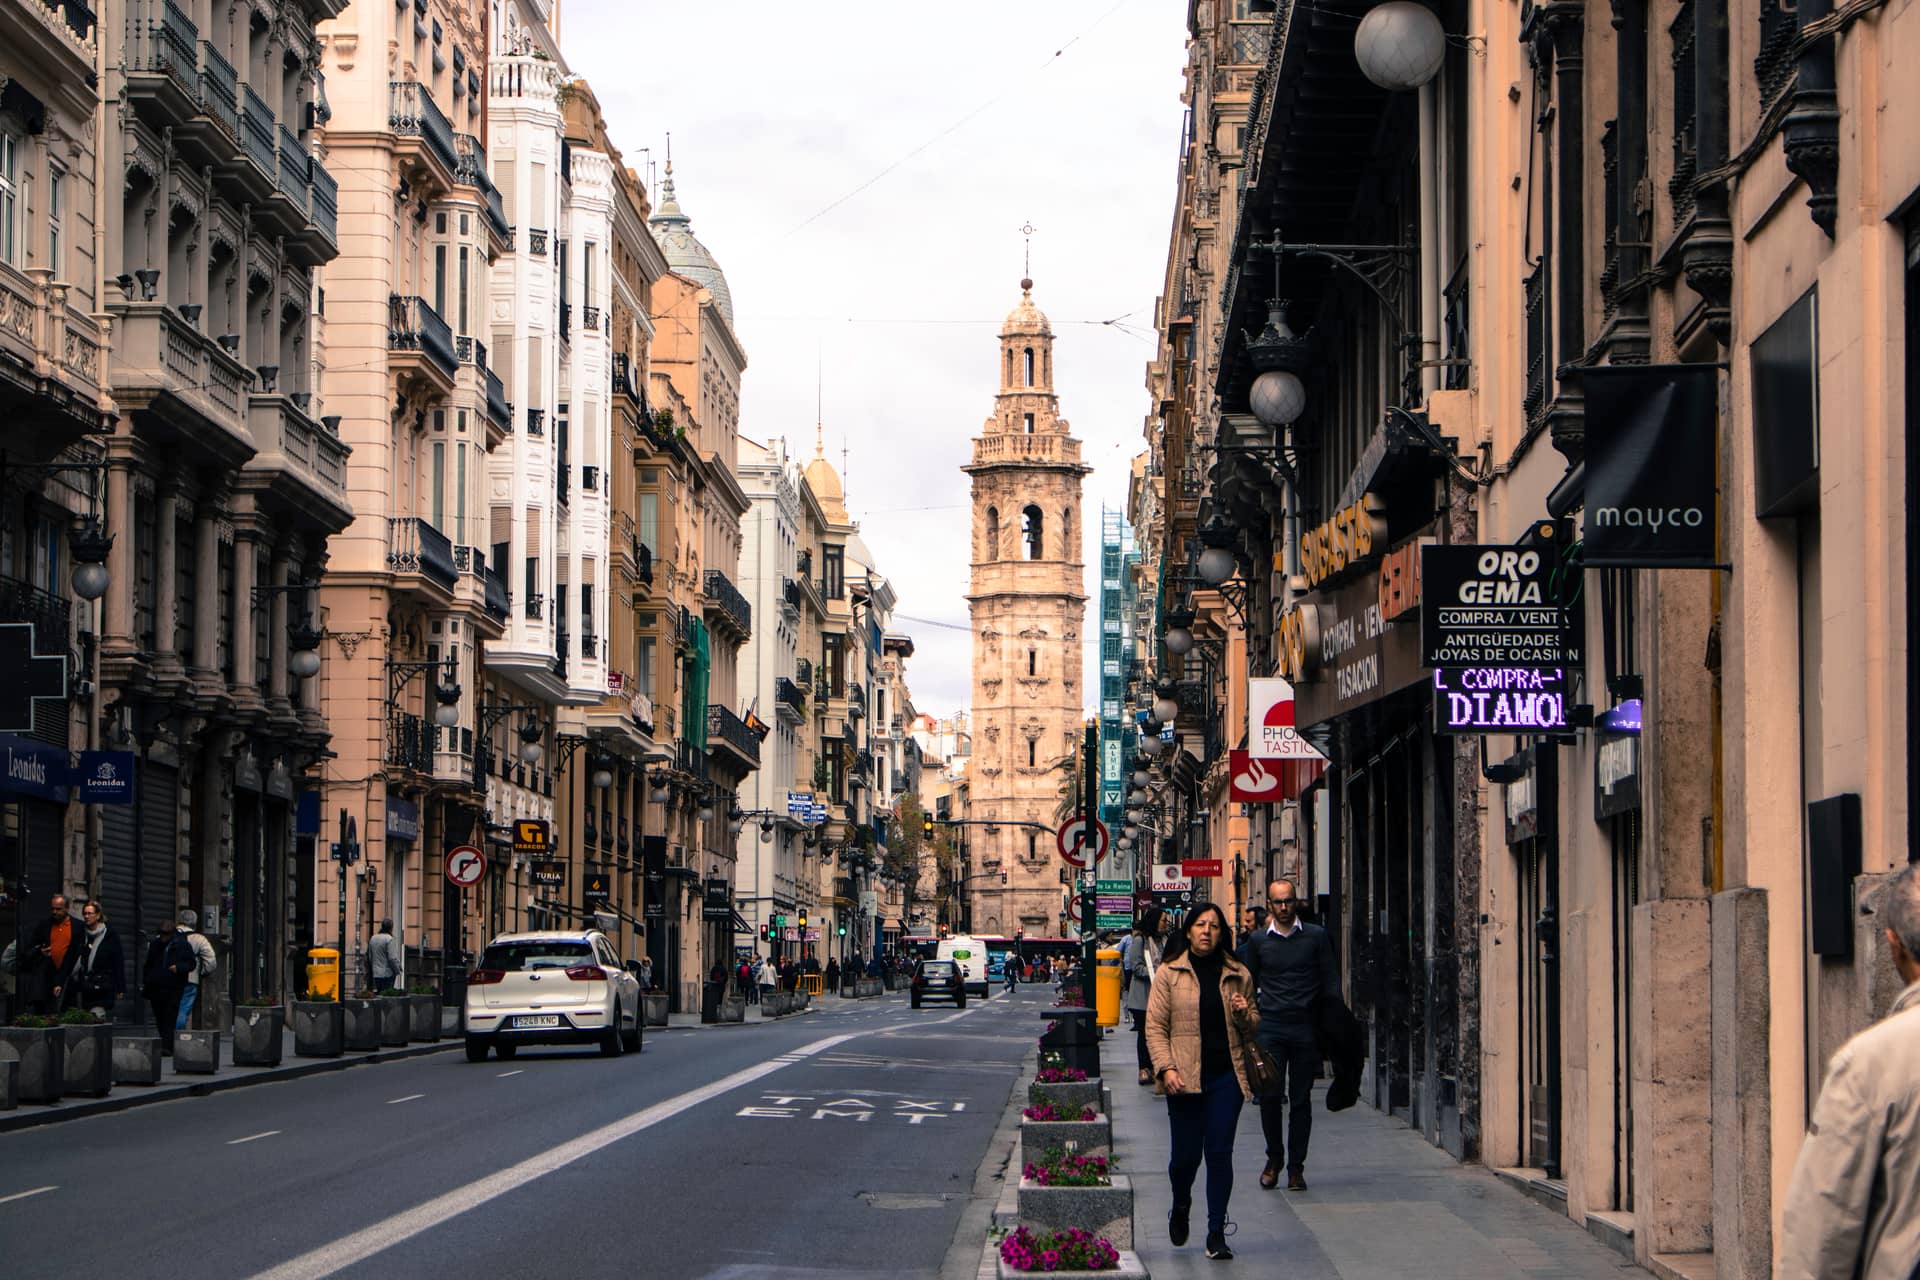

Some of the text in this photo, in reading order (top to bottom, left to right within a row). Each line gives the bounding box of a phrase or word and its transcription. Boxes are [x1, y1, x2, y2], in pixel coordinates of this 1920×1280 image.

[1596, 507, 1703, 534] mayco
[1478, 551, 1540, 581] ORO
[1459, 580, 1542, 604] GEMA
[1439, 611, 1505, 624] COMPRA
[1323, 603, 1394, 662] COMPRA VEN
[1431, 648, 1479, 661] JOYAS
[1485, 648, 1505, 661] DE
[1337, 653, 1378, 701] TASACION
[1264, 740, 1314, 754] TASTIC
[8, 746, 46, 785] Leonidas
[87, 778, 126, 787] Leonidas
[536, 872, 560, 880] TURIA
[760, 1096, 966, 1112] TAXI
[736, 1107, 948, 1124] EMT
